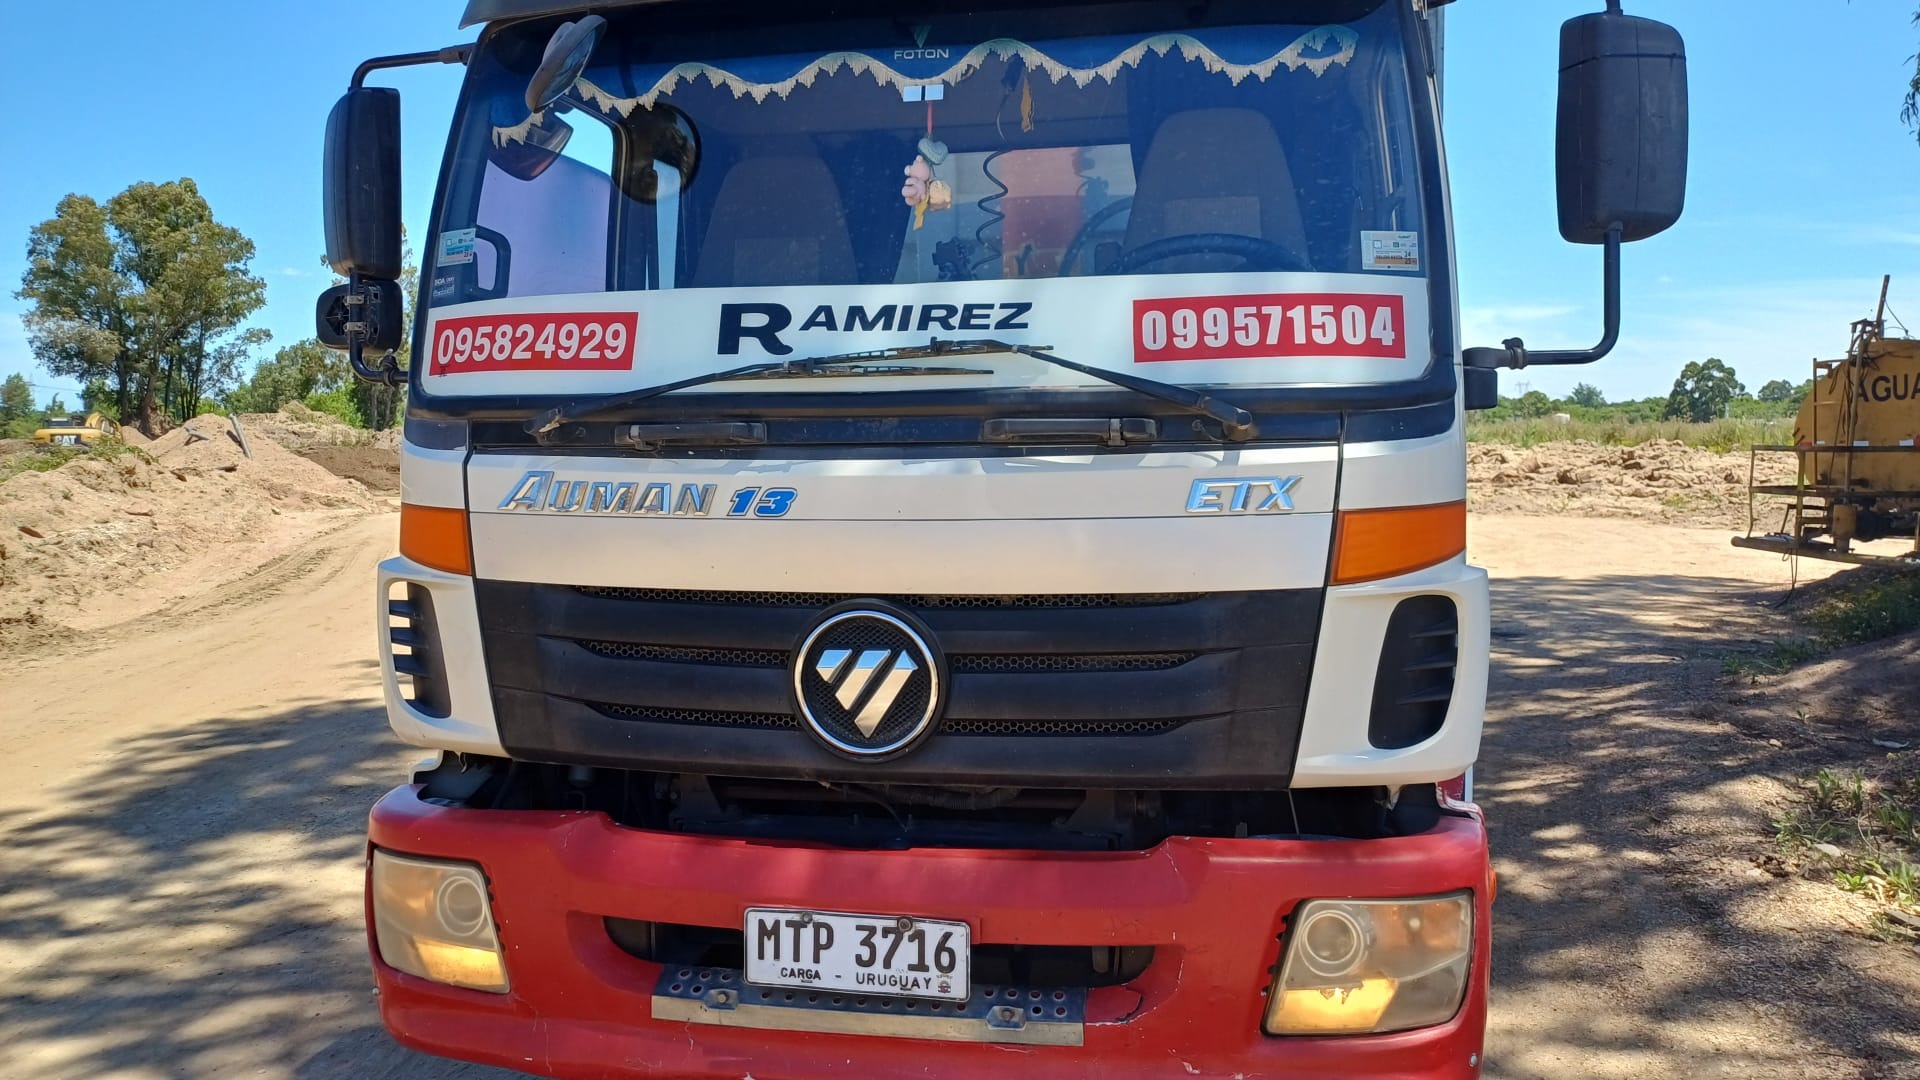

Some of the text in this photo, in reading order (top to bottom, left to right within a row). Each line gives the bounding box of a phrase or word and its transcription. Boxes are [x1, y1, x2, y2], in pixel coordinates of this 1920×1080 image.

[894, 48, 949, 60] FOTON
[437, 322, 627, 365] 095824929
[717, 302, 1033, 356] RAMIREZ
[1141, 305, 1396, 351] 099571504
[54, 435, 77, 446] CAT
[497, 470, 798, 518] AUMAN 13
[1185, 475, 1304, 513] ETX
[757, 918, 957, 974] MTP 3716
[780, 967, 821, 981] CARGA
[855, 972, 932, 990] URUGUAY
